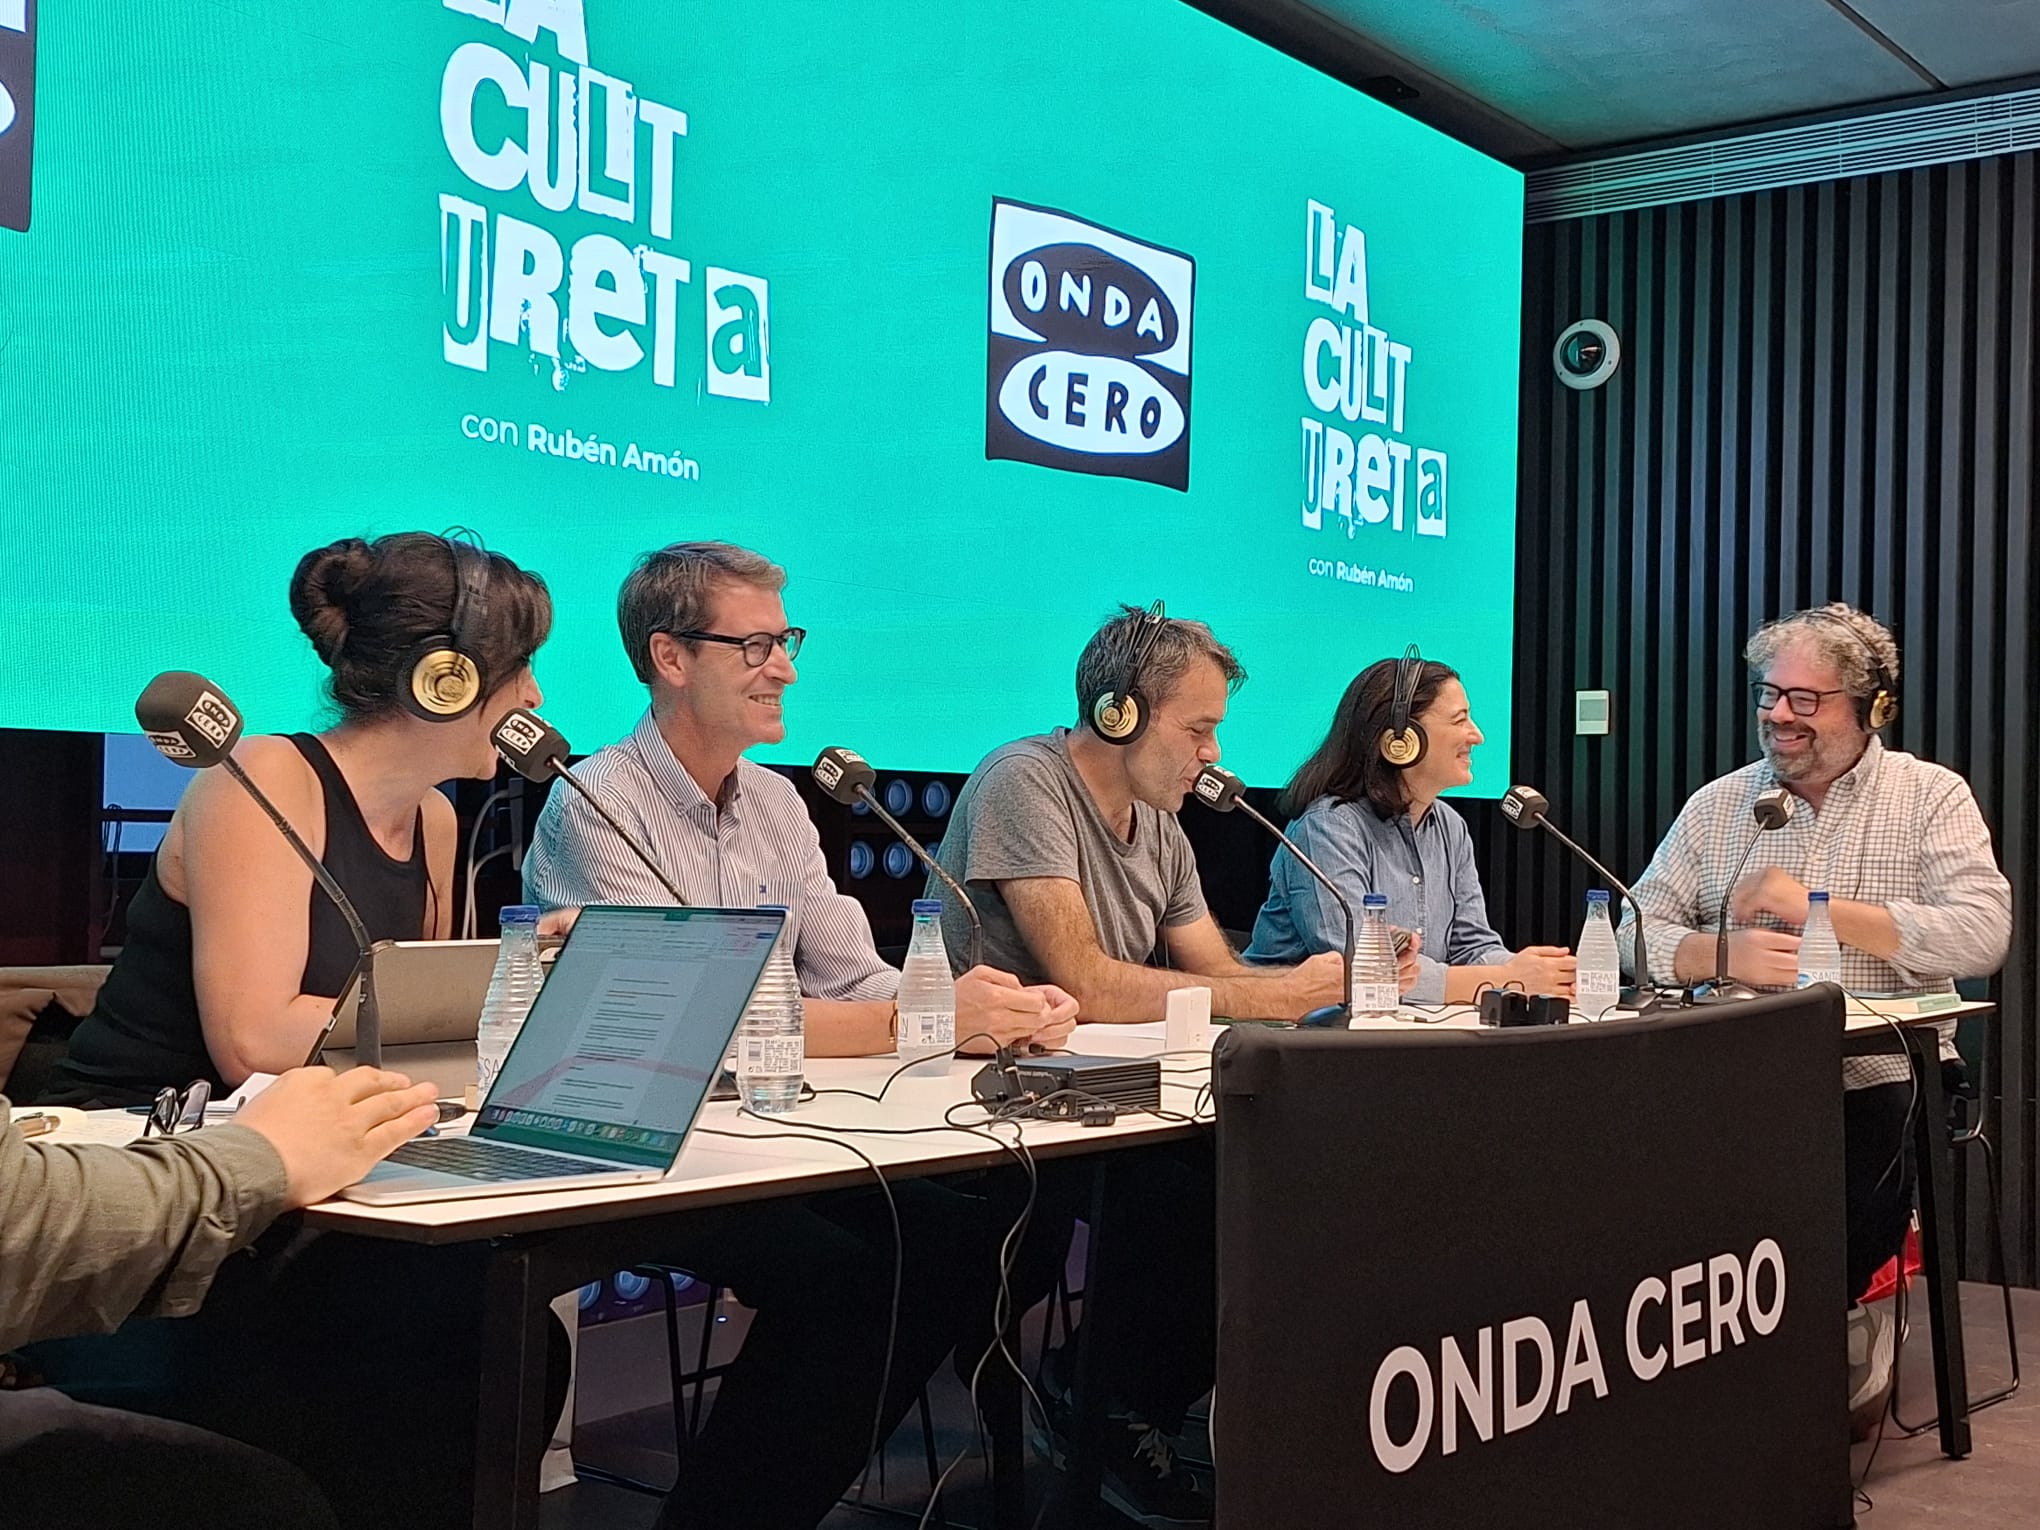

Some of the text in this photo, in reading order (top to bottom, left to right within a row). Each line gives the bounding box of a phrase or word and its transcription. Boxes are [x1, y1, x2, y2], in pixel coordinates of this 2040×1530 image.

[440, 43, 688, 240] CULT
[1020, 260, 1165, 343] ONDA
[1305, 199, 1368, 325] LA
[1028, 364, 1162, 440] CERO
[1303, 318, 1411, 433] CULT
[460, 414, 699, 481] con Rubén Amón
[1308, 558, 1414, 593] con Rubén Amón
[203, 700, 230, 727] ONDA
[511, 718, 537, 738] ONDA
[1625, 1237, 1787, 1382] CERO
[1369, 1298, 1609, 1474] ONDA
